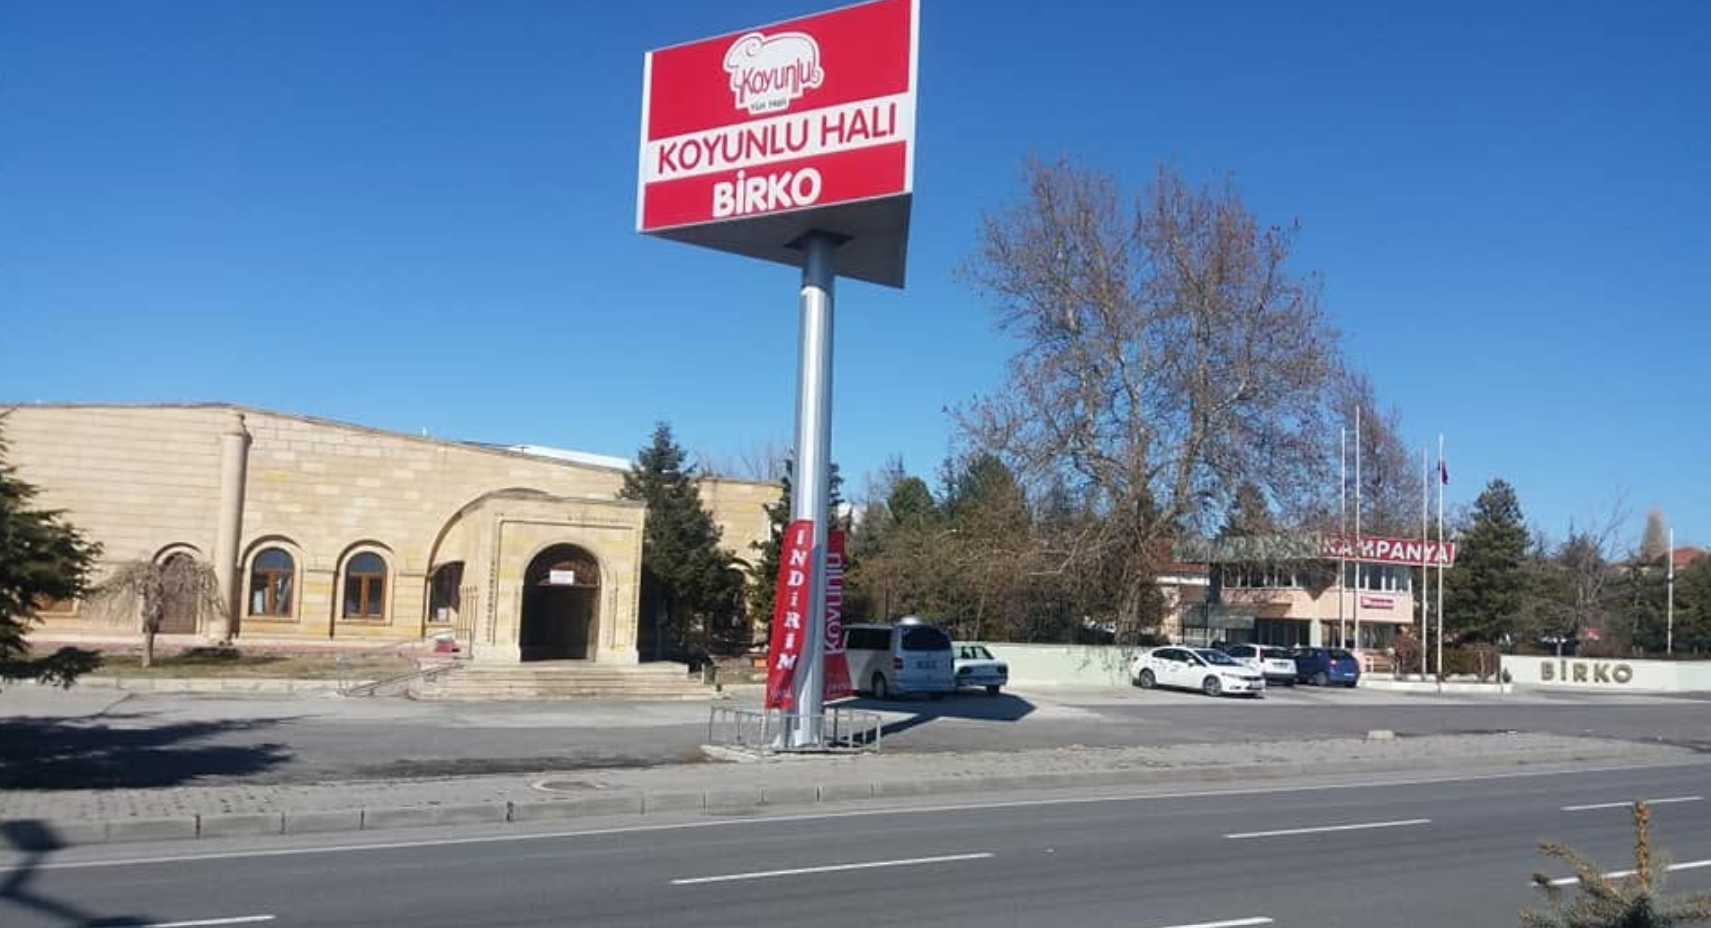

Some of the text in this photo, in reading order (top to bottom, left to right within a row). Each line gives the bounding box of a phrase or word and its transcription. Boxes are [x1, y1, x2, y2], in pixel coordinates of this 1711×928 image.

[739, 58, 812, 103] Koyunlu
[658, 102, 896, 174] KOYUNLU HALI
[712, 168, 822, 218] BİRKO
